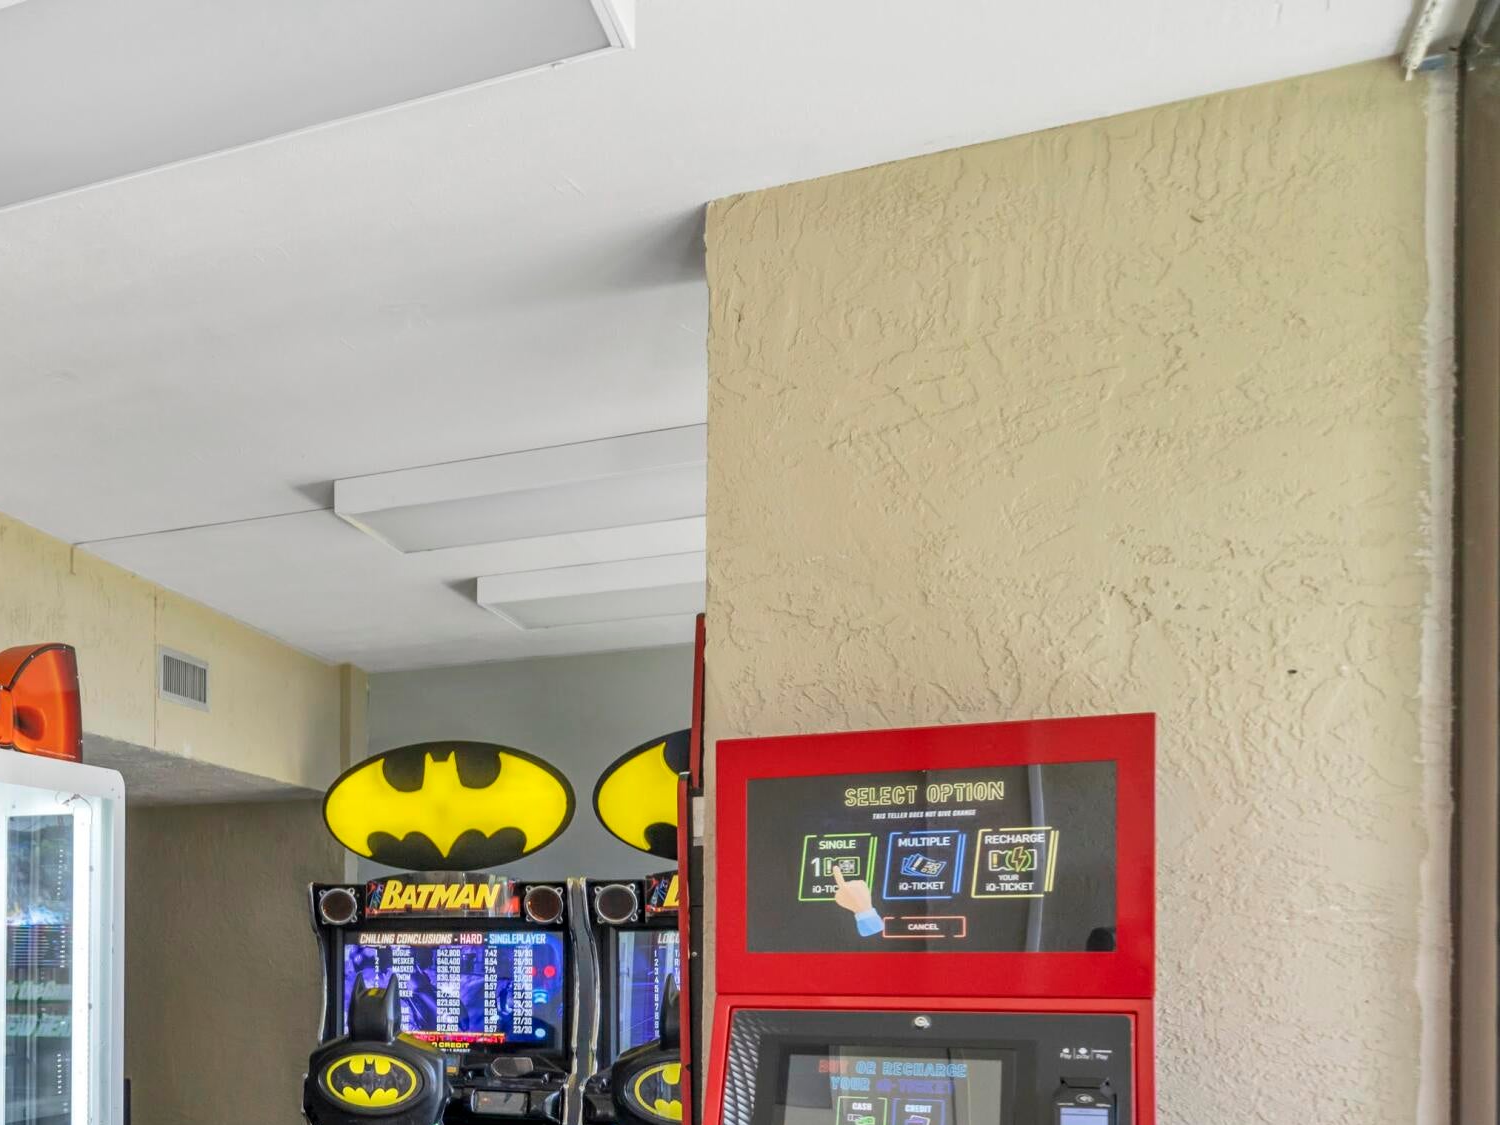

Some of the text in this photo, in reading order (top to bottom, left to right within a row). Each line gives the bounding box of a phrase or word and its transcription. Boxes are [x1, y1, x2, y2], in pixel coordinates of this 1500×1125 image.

[844, 781, 1005, 807] SELECT OPTION
[872, 812, 886, 820] THIS
[887, 812, 908, 820] TELLER
[952, 809, 977, 817] CHANGE
[898, 837, 951, 848] MULTIPLE
[984, 833, 1046, 845] RECHARGE
[818, 840, 857, 850] SINGLE
[998, 874, 1020, 882] YOUR
[379, 879, 501, 911] BATMAN
[907, 922, 940, 931] CANCEL
[359, 933, 396, 945] CHILLING
[396, 933, 453, 945] CONCLUSIONS
[459, 933, 483, 945] HARD
[489, 933, 546, 945] SINGLEPLAYER
[438, 1041, 470, 1049] CREDIT
[818, 1059, 968, 1078] BUY OR RECHARGE
[830, 1076, 871, 1092] YOUR
[851, 1102, 873, 1111] CASH
[904, 1104, 933, 1113] CREDIT
